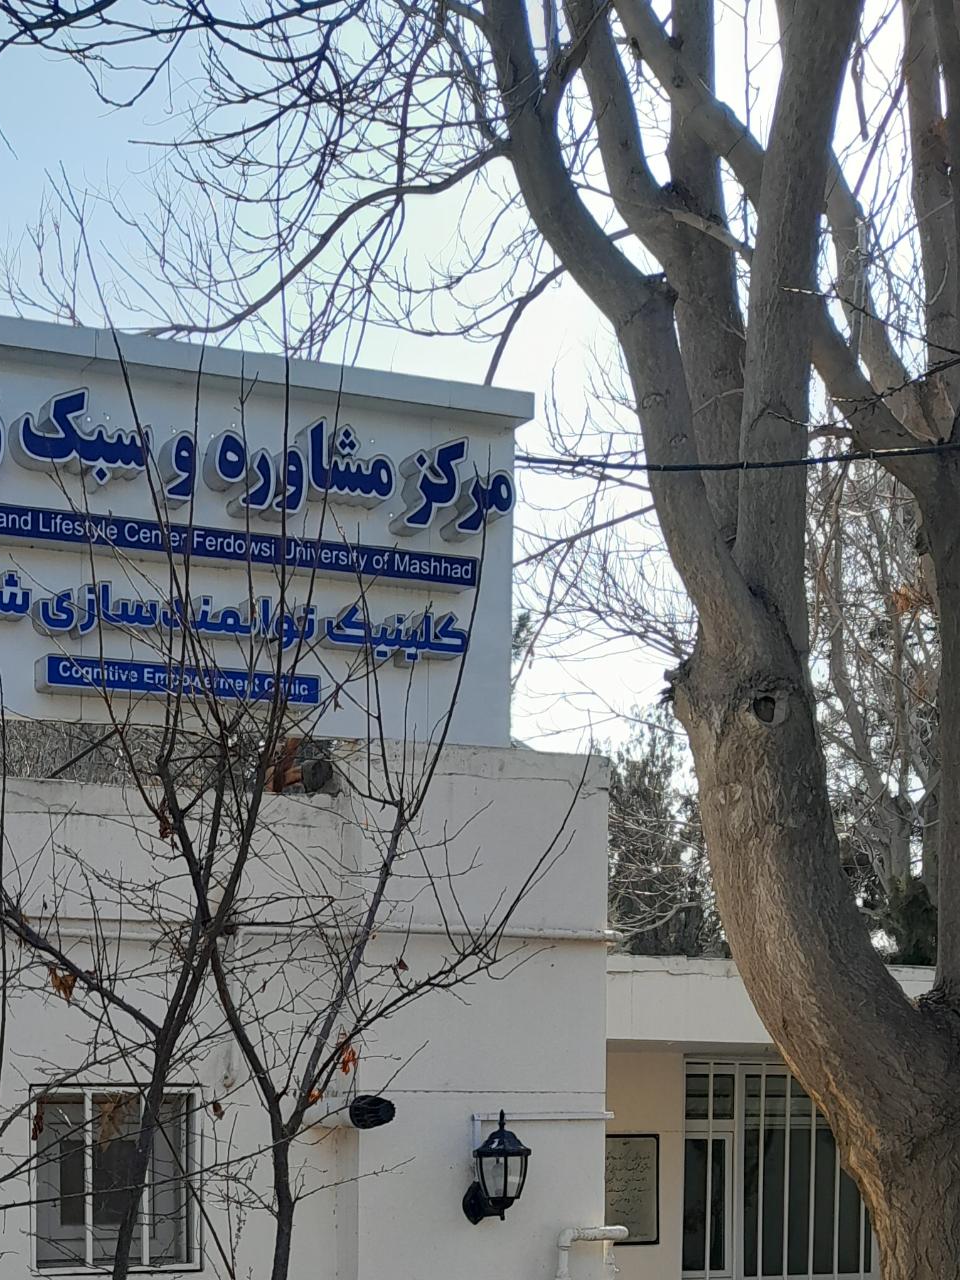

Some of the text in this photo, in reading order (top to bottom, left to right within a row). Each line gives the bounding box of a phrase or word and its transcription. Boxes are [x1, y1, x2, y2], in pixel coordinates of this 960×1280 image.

[19, 388, 152, 484] سبک
[166, 432, 198, 498] و
[217, 418, 394, 513] مشاوره
[405, 437, 515, 534] مرکز
[39, 512, 118, 543] Lifestyle
[124, 522, 188, 547] Cener
[193, 530, 276, 557] Ferdowsi
[283, 541, 368, 571] University
[372, 550, 390, 570] of
[394, 554, 473, 580] Mashhad
[325, 603, 468, 662] کلینیک
[58, 661, 309, 695] Cognitive Empowerment Cinic
